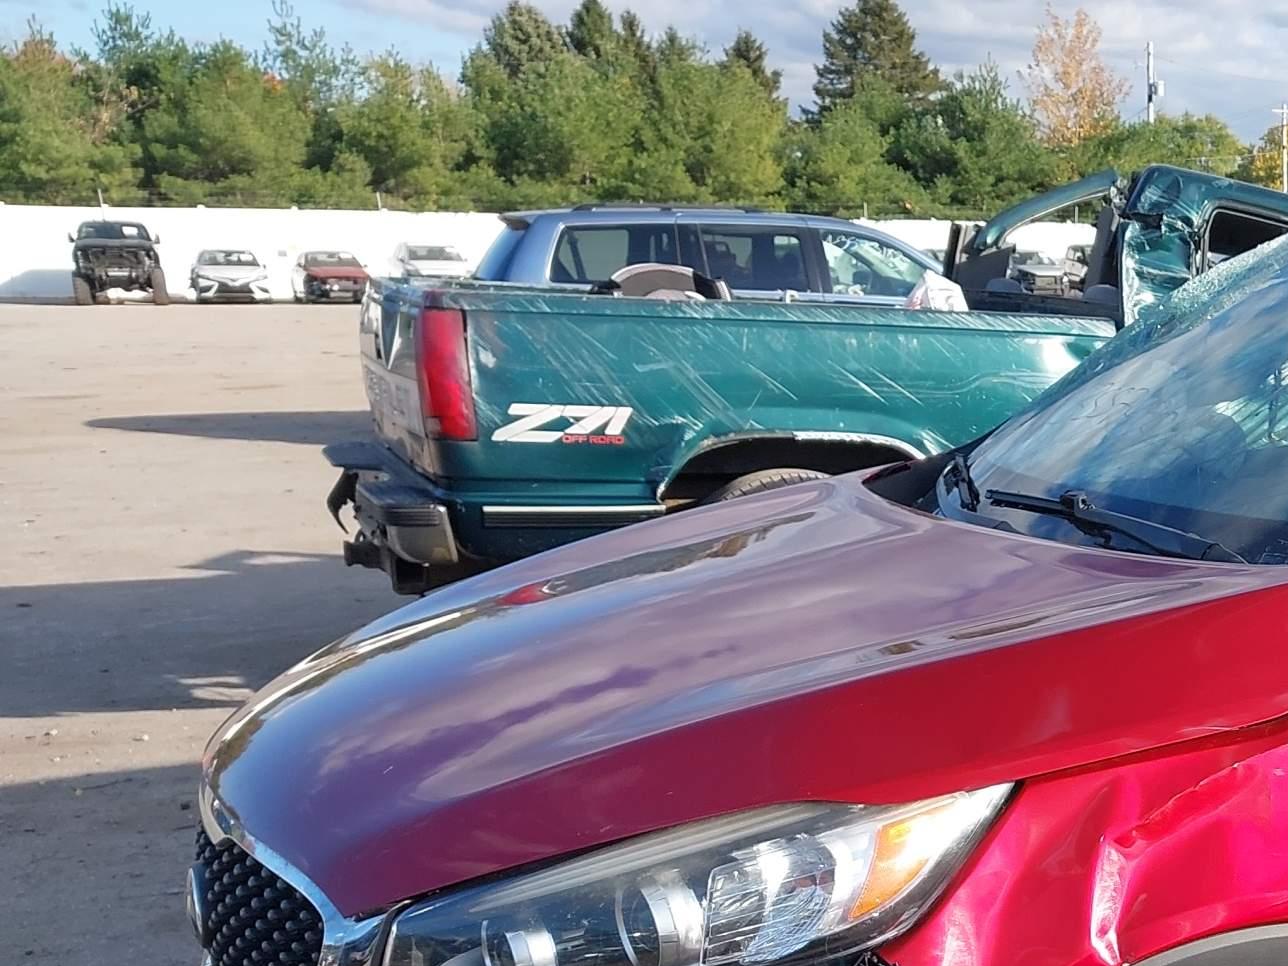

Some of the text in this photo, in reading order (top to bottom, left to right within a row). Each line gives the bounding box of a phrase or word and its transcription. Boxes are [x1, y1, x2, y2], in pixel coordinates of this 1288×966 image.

[491, 403, 633, 443] Z71
[562, 435, 625, 444] OFF ROAD
